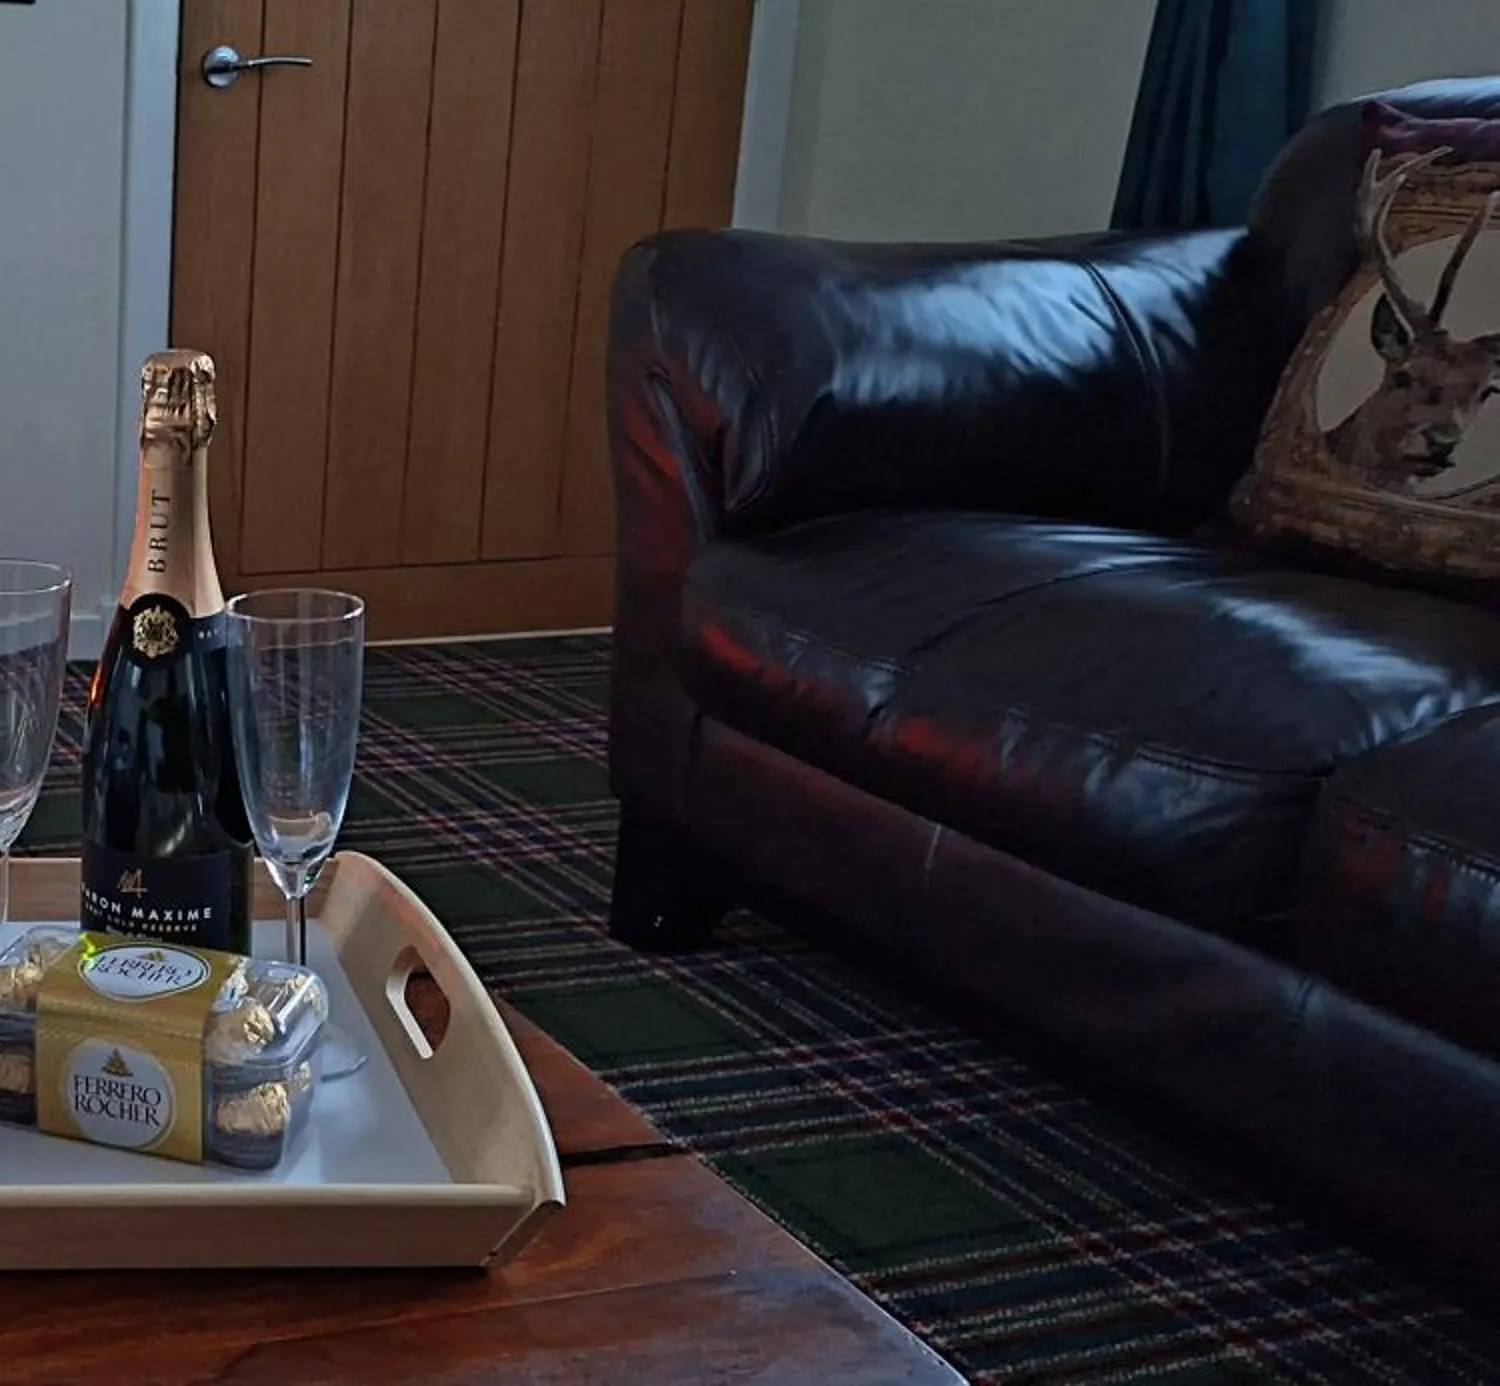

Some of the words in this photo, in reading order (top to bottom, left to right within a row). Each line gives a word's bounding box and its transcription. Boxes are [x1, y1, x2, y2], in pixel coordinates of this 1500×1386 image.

[148, 489, 171, 573] BRUT
[130, 905, 212, 921] MAXIME
[73, 1073, 162, 1106] FERRERO
[74, 1093, 161, 1126] ROCHER
